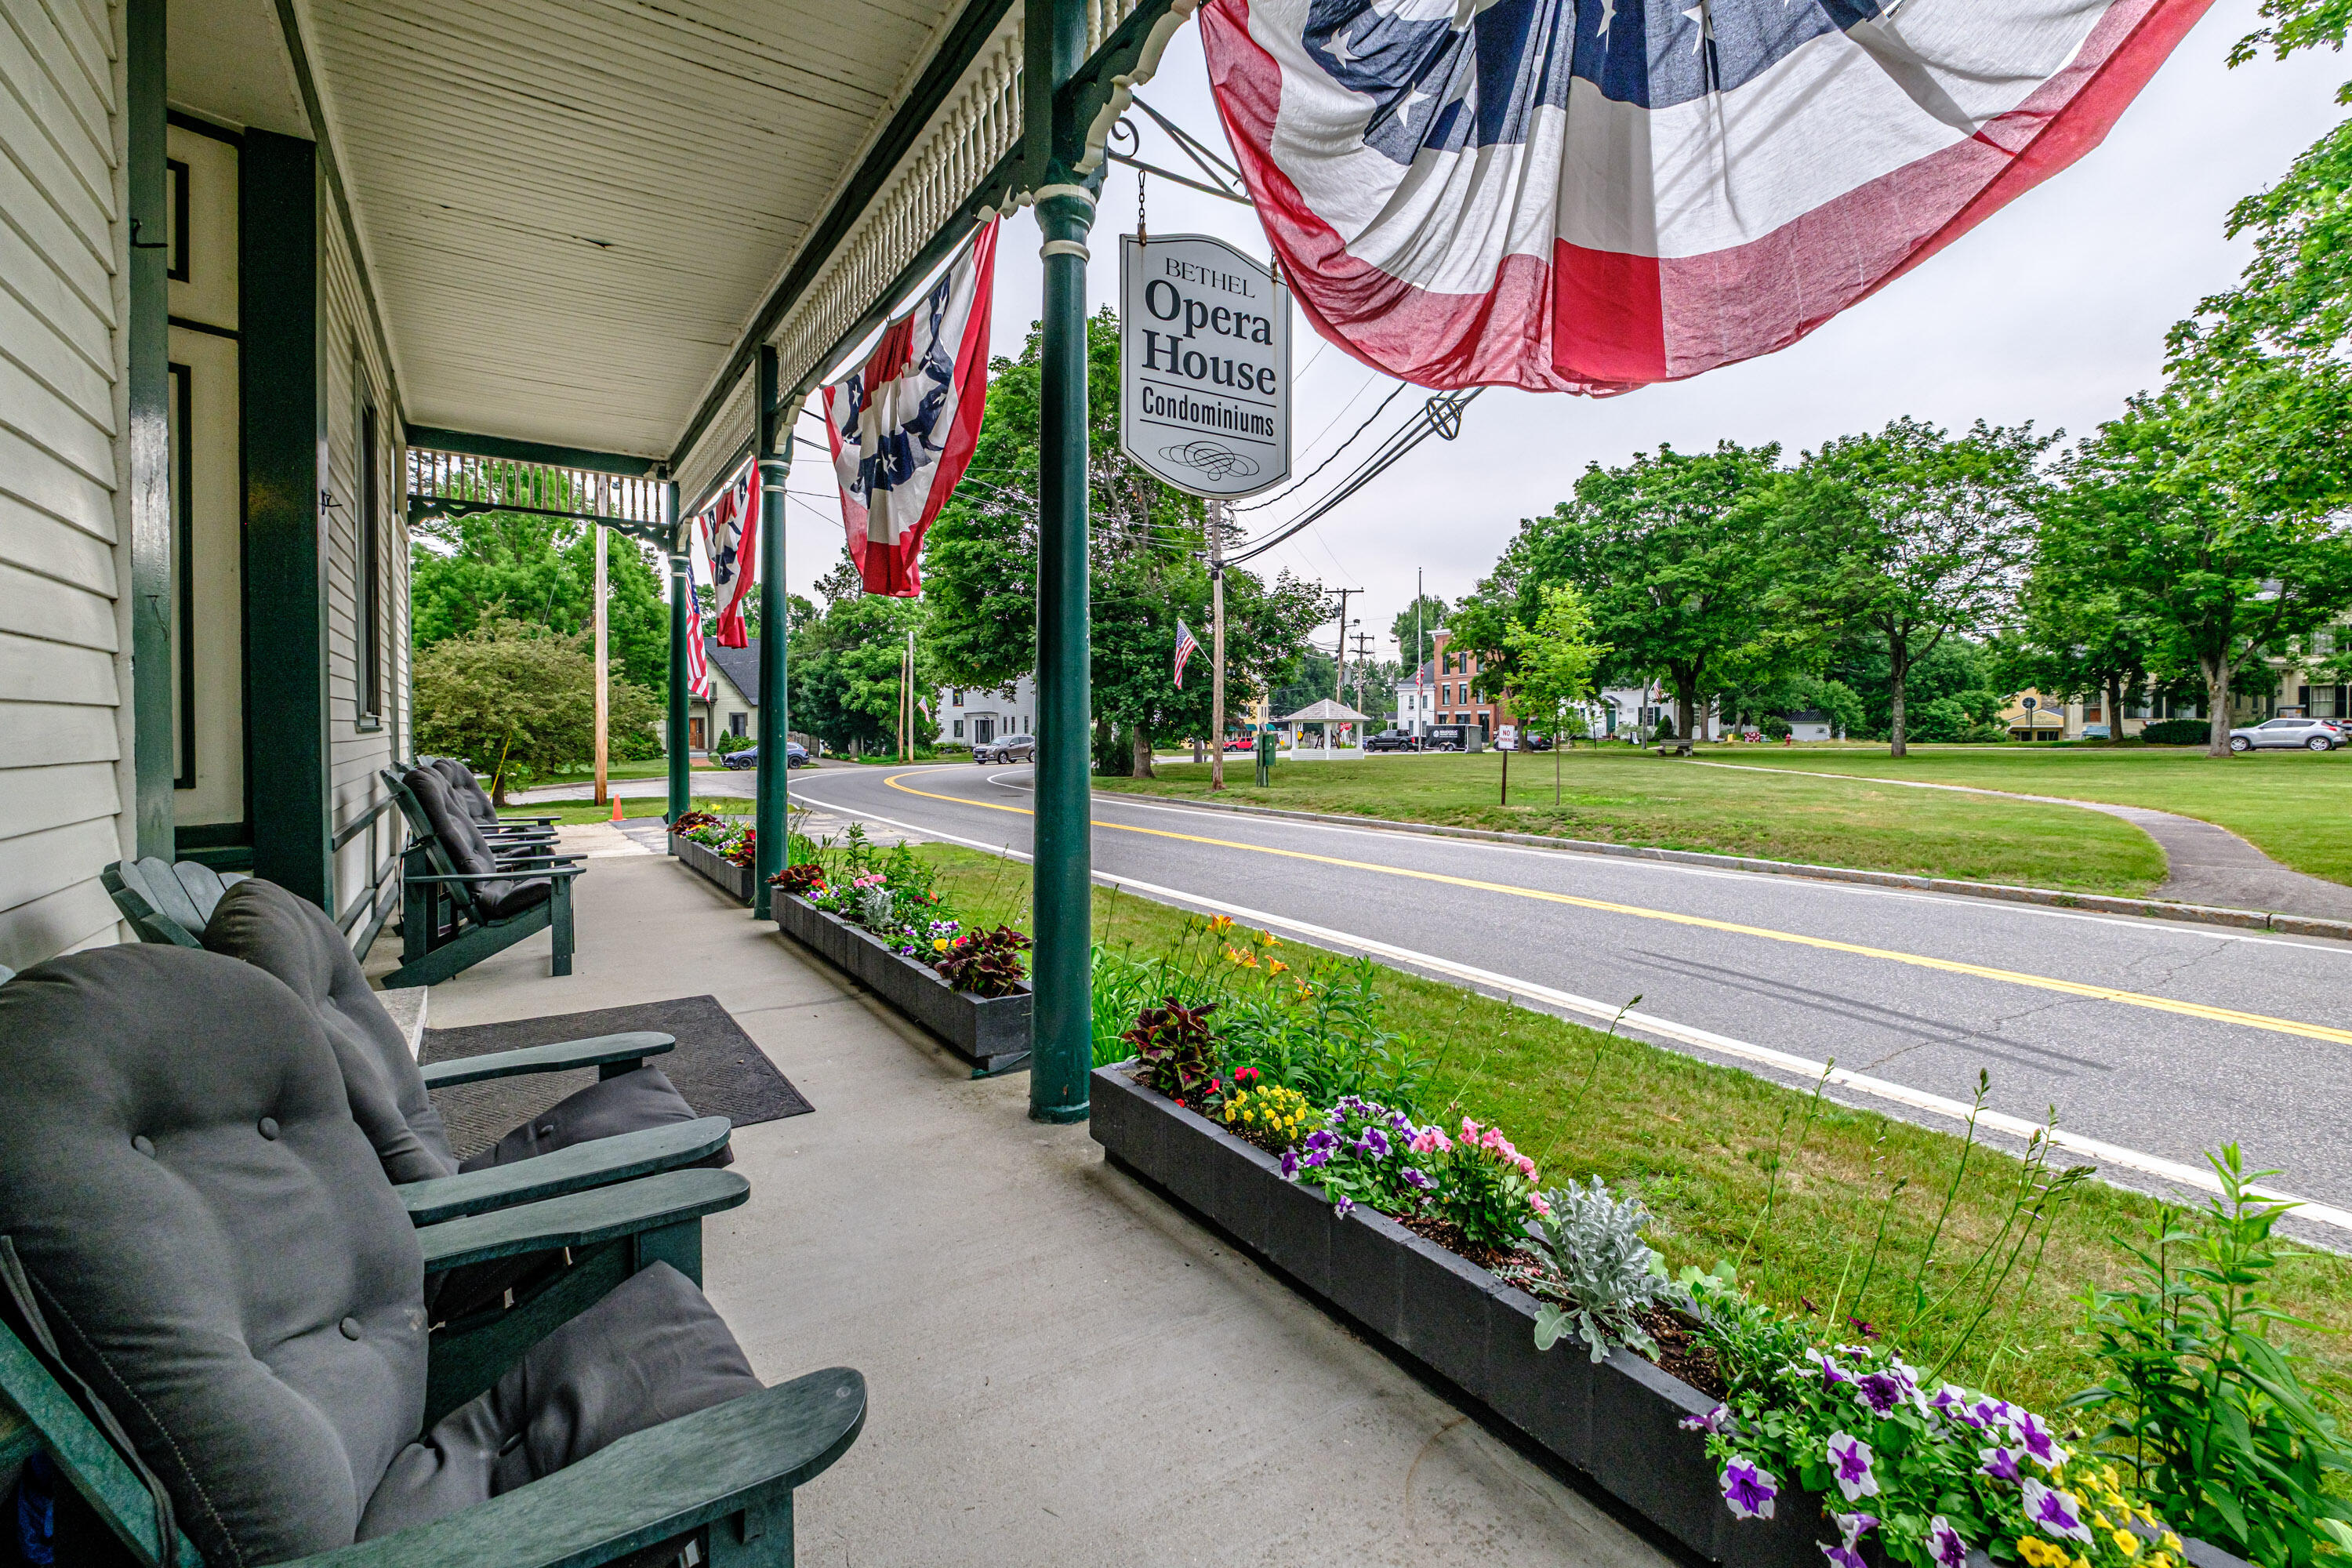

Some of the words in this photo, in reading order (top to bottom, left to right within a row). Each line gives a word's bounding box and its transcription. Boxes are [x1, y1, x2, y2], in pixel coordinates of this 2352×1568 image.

[1166, 257, 1256, 299] BETHEL
[1145, 279, 1273, 346] Opera
[1142, 328, 1276, 396] House
[1142, 386, 1274, 437] Condominiums
